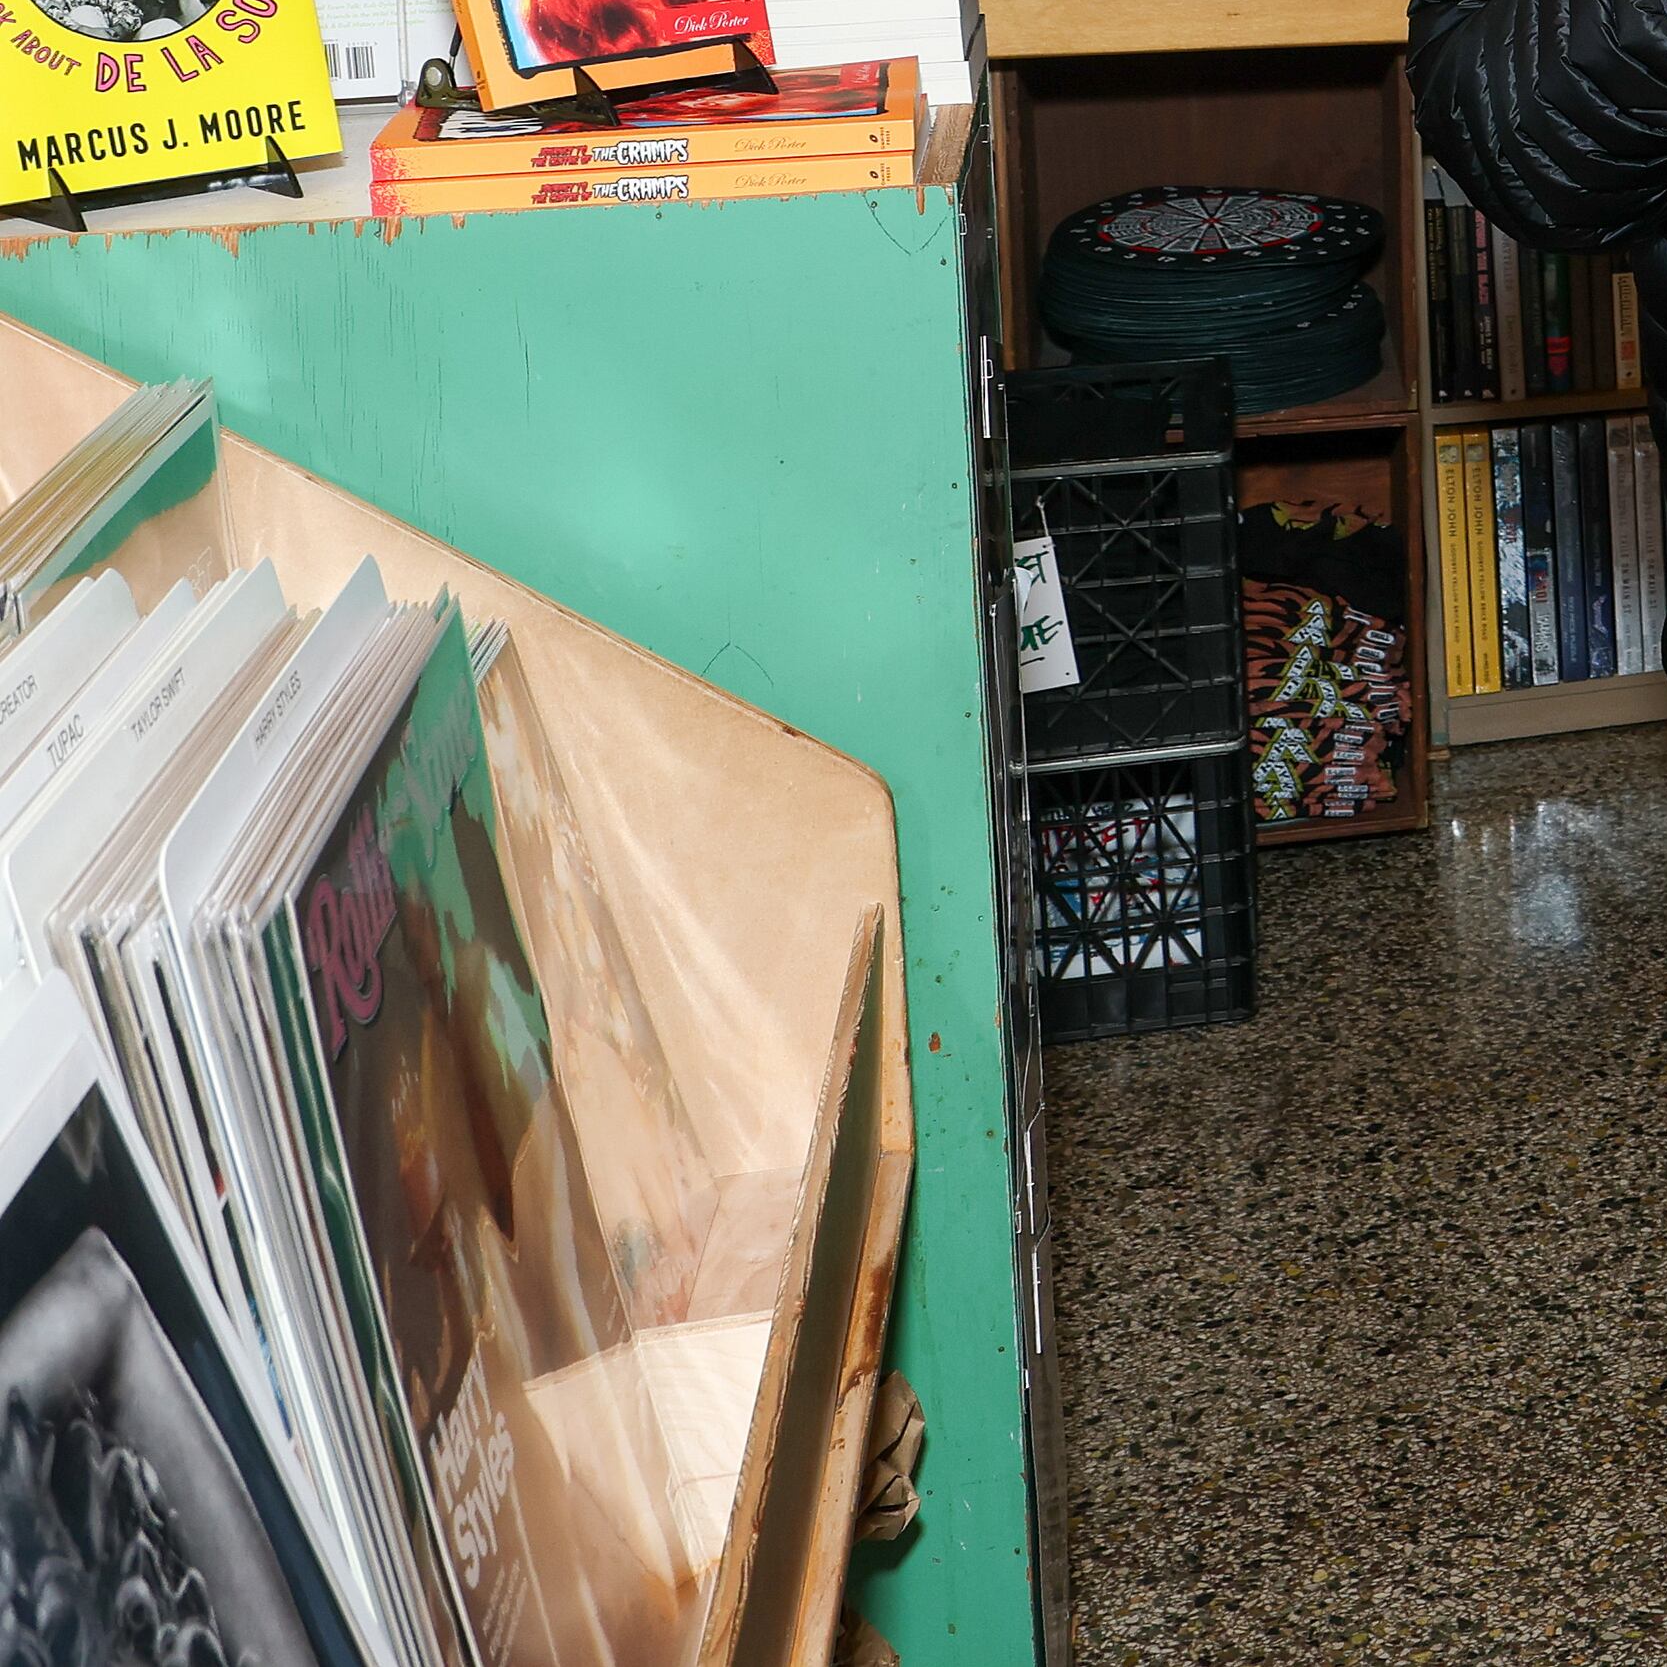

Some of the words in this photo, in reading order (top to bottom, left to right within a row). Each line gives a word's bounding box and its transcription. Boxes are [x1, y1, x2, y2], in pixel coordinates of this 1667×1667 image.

[673, 16, 707, 36] Dick
[707, 13, 750, 32] Porter
[11, 28, 82, 79] ABOUT
[95, 51, 148, 93] DE
[161, 34, 224, 84] LA
[18, 122, 148, 172] MARCUS
[163, 118, 189, 151] J.
[199, 100, 307, 145] MOORE
[592, 146, 616, 162] THE
[616, 139, 688, 165] CRAMPS
[592, 183, 616, 199] THE
[616, 175, 688, 201] CRAMPS
[1445, 468, 1456, 504] ELTON
[1472, 466, 1482, 503] ELTON
[1447, 508, 1457, 538] JOHN
[1473, 506, 1484, 536] JOHN
[130, 690, 163, 743] TAYLOR
[160, 666, 187, 707] SWIFT
[274, 669, 303, 719] STYLES
[46, 713, 86, 769] TUPAC
[430, 1342, 492, 1515] Harry
[454, 1410, 515, 1590] Styles
